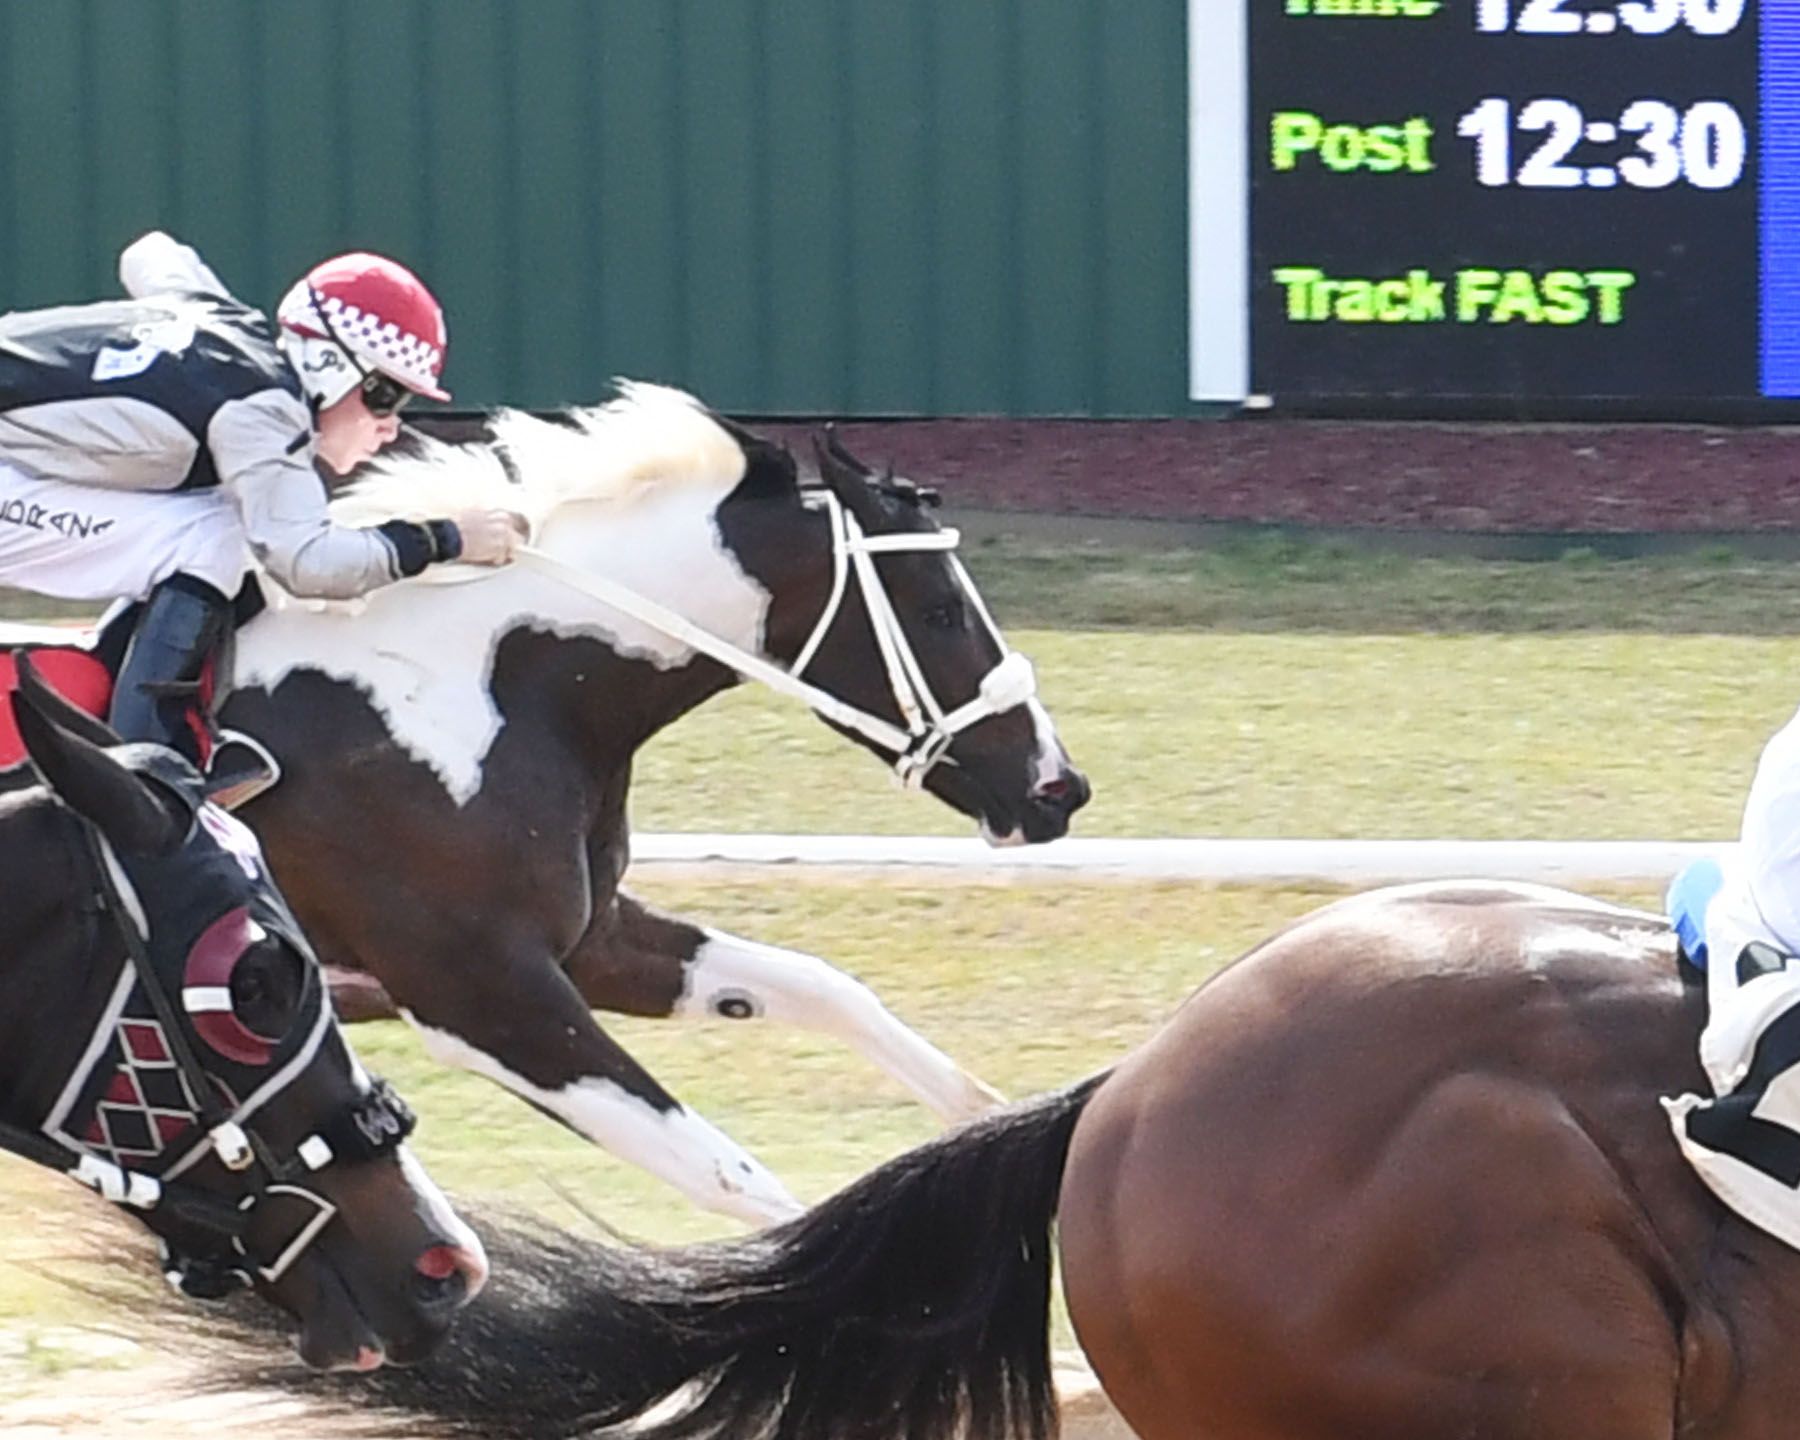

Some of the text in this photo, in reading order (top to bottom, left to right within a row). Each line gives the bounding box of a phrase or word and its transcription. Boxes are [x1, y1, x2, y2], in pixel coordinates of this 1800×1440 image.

[1270, 99, 1747, 189] Post 12:30
[1273, 268, 1636, 325] Track FAST
